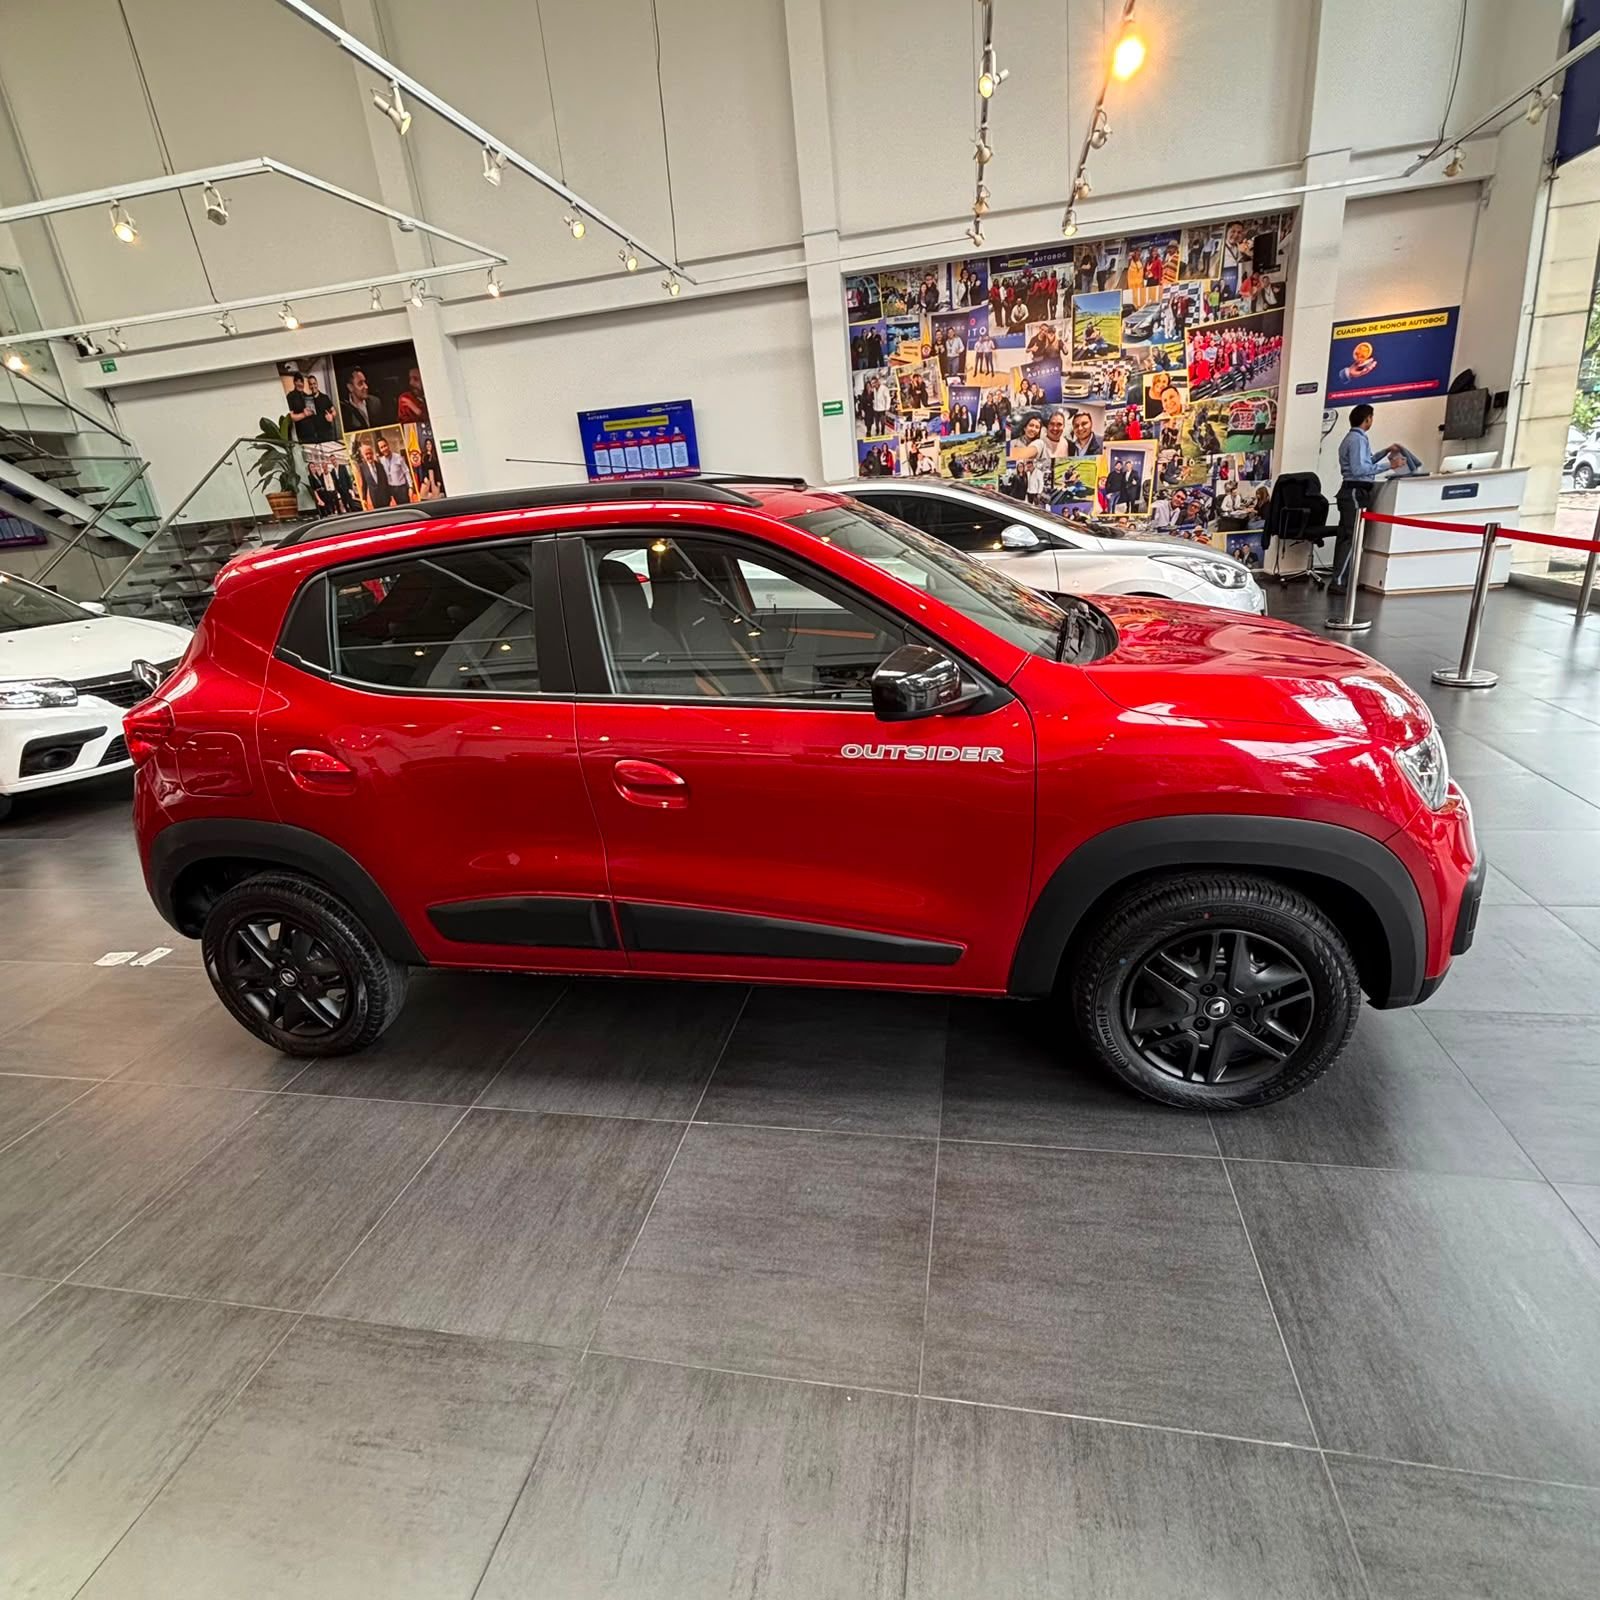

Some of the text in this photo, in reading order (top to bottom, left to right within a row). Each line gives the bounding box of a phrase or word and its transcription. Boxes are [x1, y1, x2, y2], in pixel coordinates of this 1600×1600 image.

[1336, 315, 1445, 336] CUADRO DE HONOR AUTOBOG
[841, 742, 1005, 763] OUTSIDER
[1097, 1012, 1129, 1069] Continental
